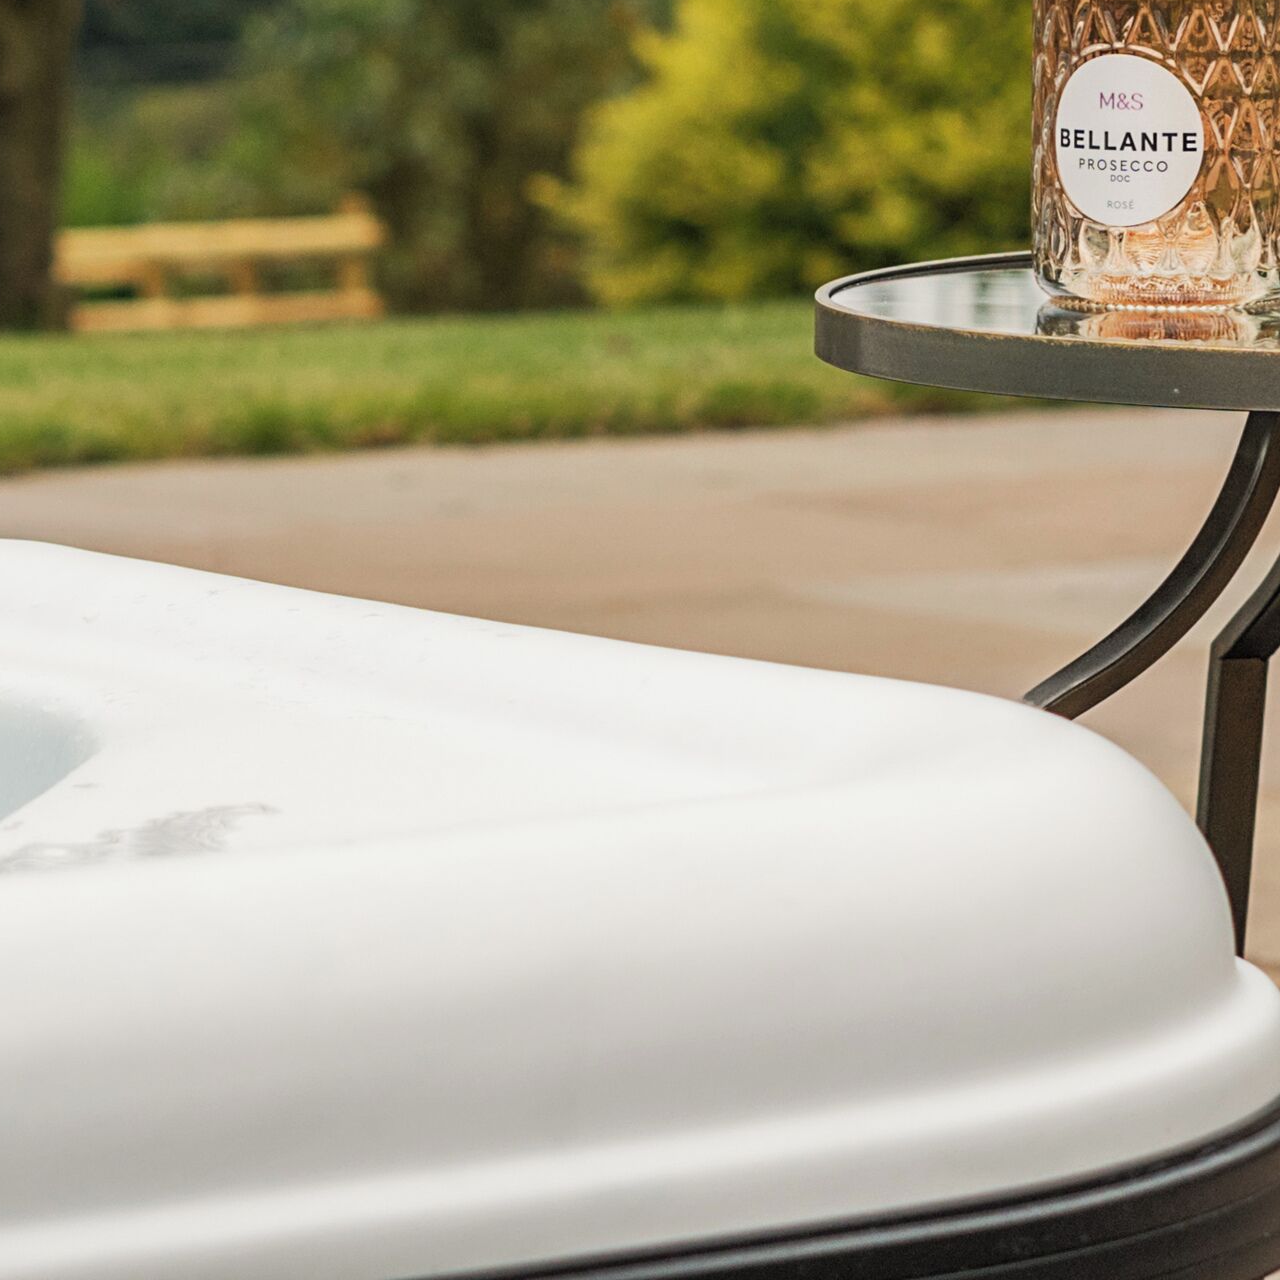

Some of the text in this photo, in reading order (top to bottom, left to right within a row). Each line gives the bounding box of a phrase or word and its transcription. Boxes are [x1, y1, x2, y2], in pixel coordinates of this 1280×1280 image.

[1100, 91, 1144, 111] M&S
[1060, 127, 1198, 152] BELLANTE
[1078, 158, 1169, 173] PROSECCO
[1110, 174, 1131, 183] DOC
[1106, 199, 1135, 210] ROSÉ
